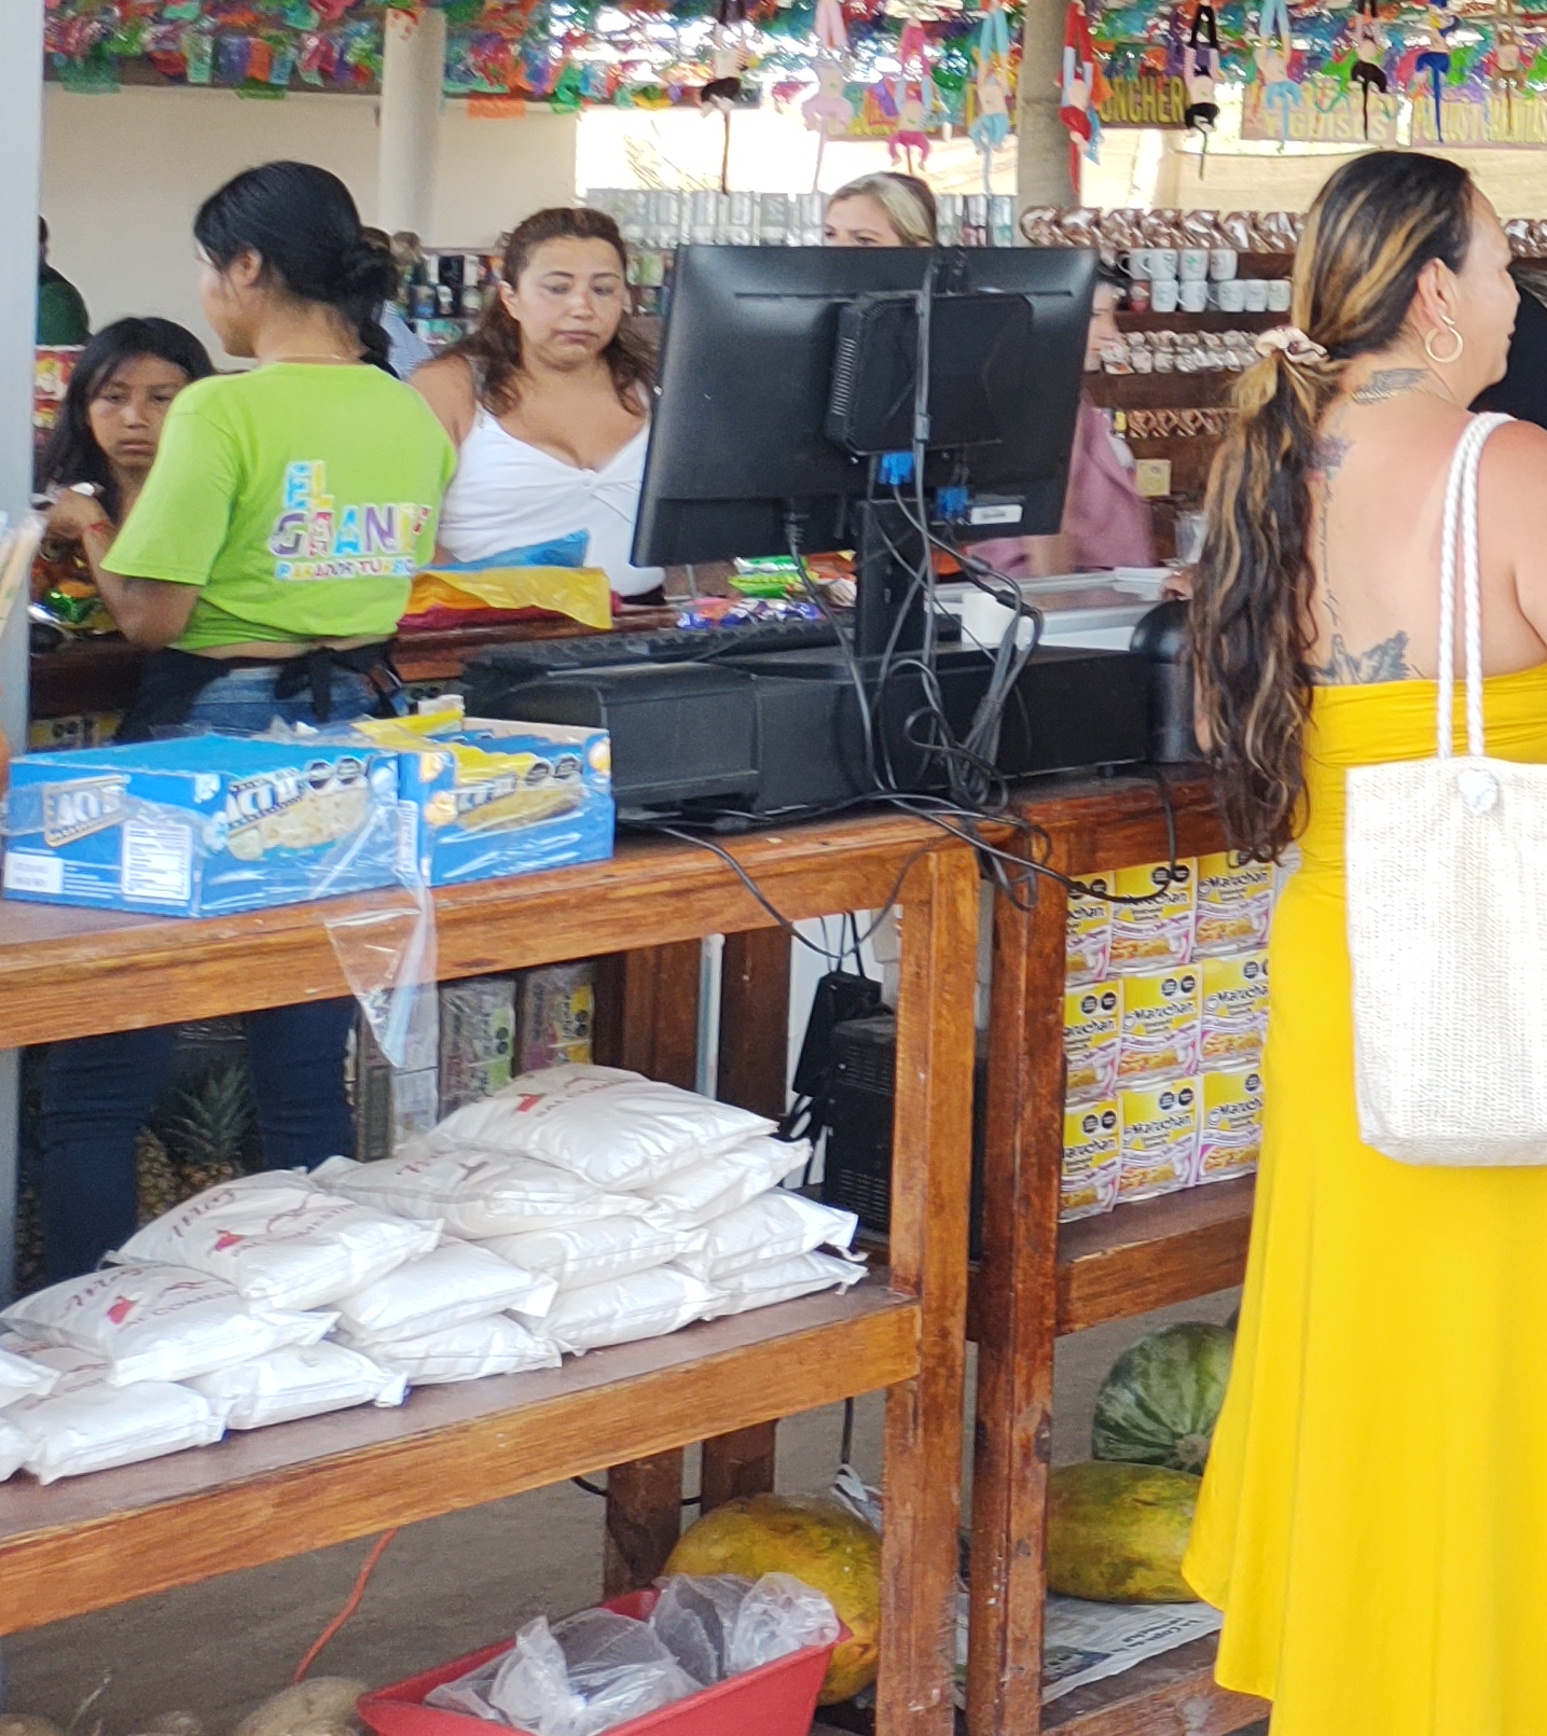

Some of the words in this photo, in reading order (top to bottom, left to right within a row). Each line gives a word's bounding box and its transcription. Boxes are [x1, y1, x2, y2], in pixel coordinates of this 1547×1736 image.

[284, 460, 335, 510] EL
[268, 503, 432, 558] GRAN
[1217, 984, 1267, 1003] Marucha
[1064, 1019, 1115, 1038] aruchan
[1220, 1098, 1263, 1115] Maruch
[1065, 1138, 1117, 1158] aruchan
